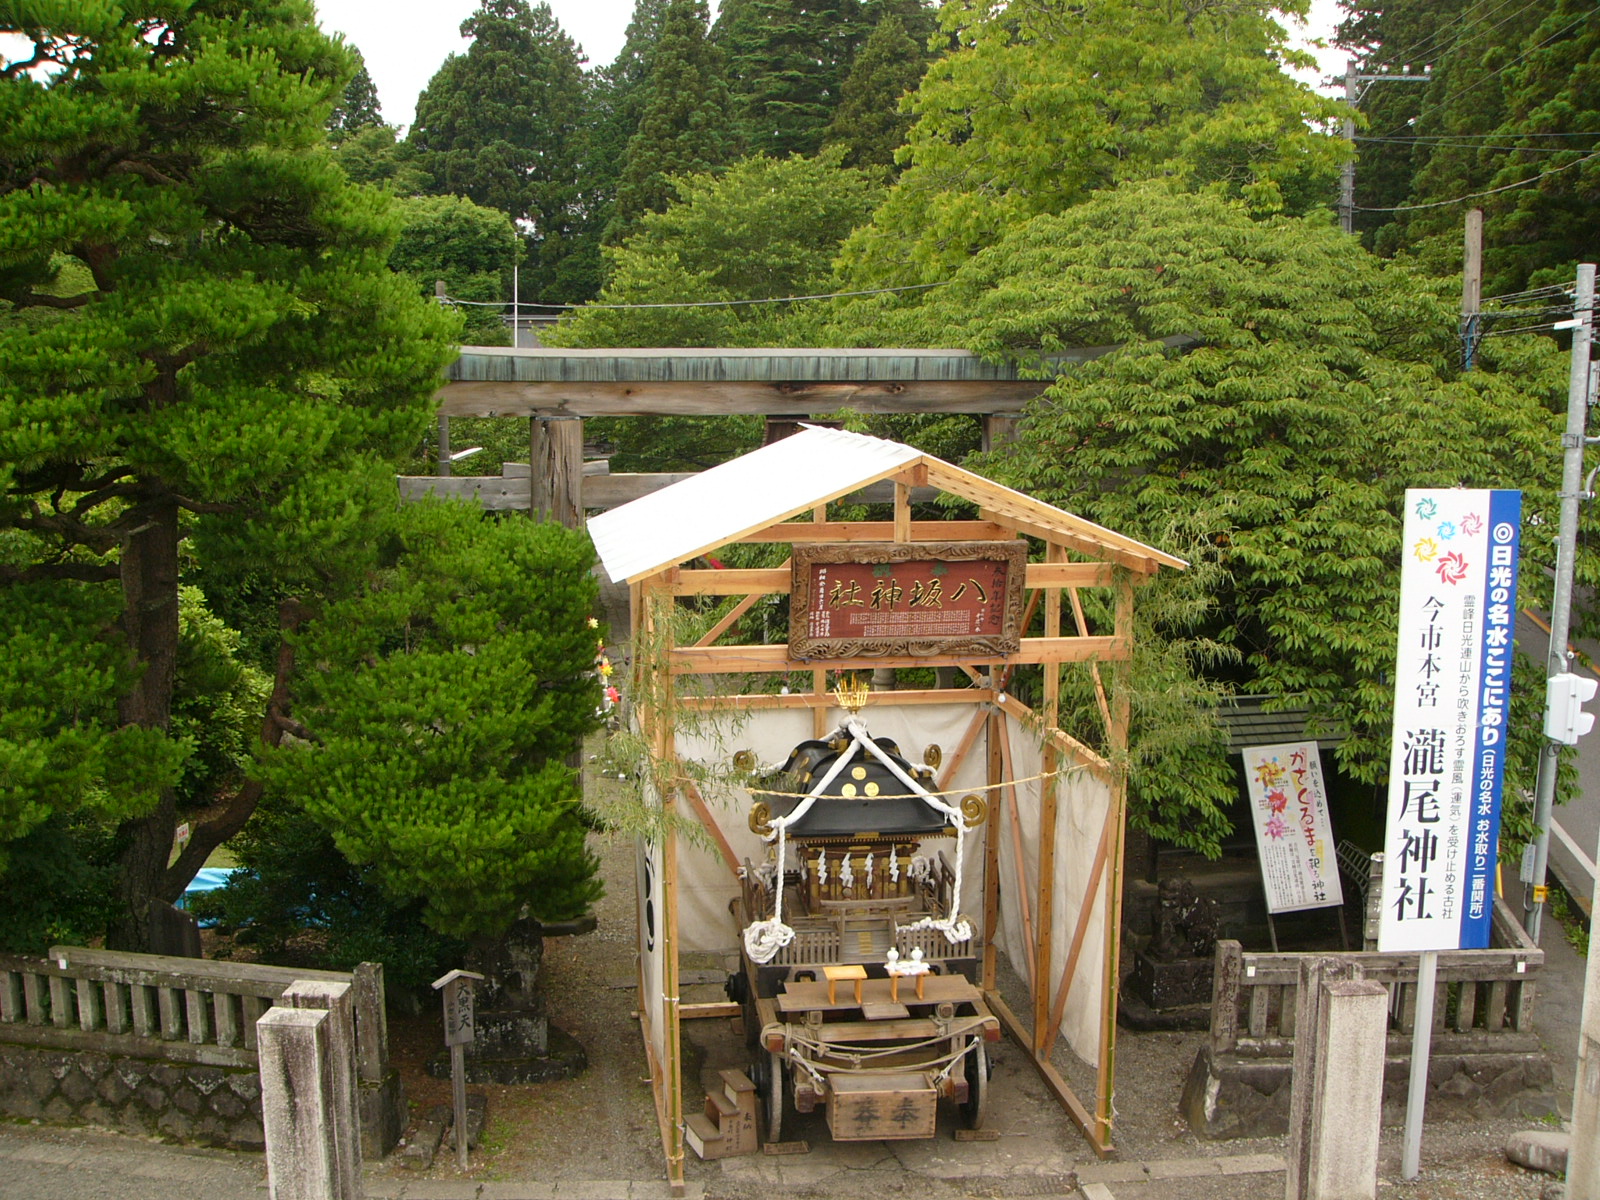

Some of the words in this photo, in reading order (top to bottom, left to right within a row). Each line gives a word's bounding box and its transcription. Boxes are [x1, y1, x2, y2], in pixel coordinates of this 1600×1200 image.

[829, 579, 989, 611] 八坂神社
[1416, 595, 1445, 708] 今市本宮
[1391, 728, 1446, 921] 瀧尾神社
[457, 982, 471, 1031] 大黒天
